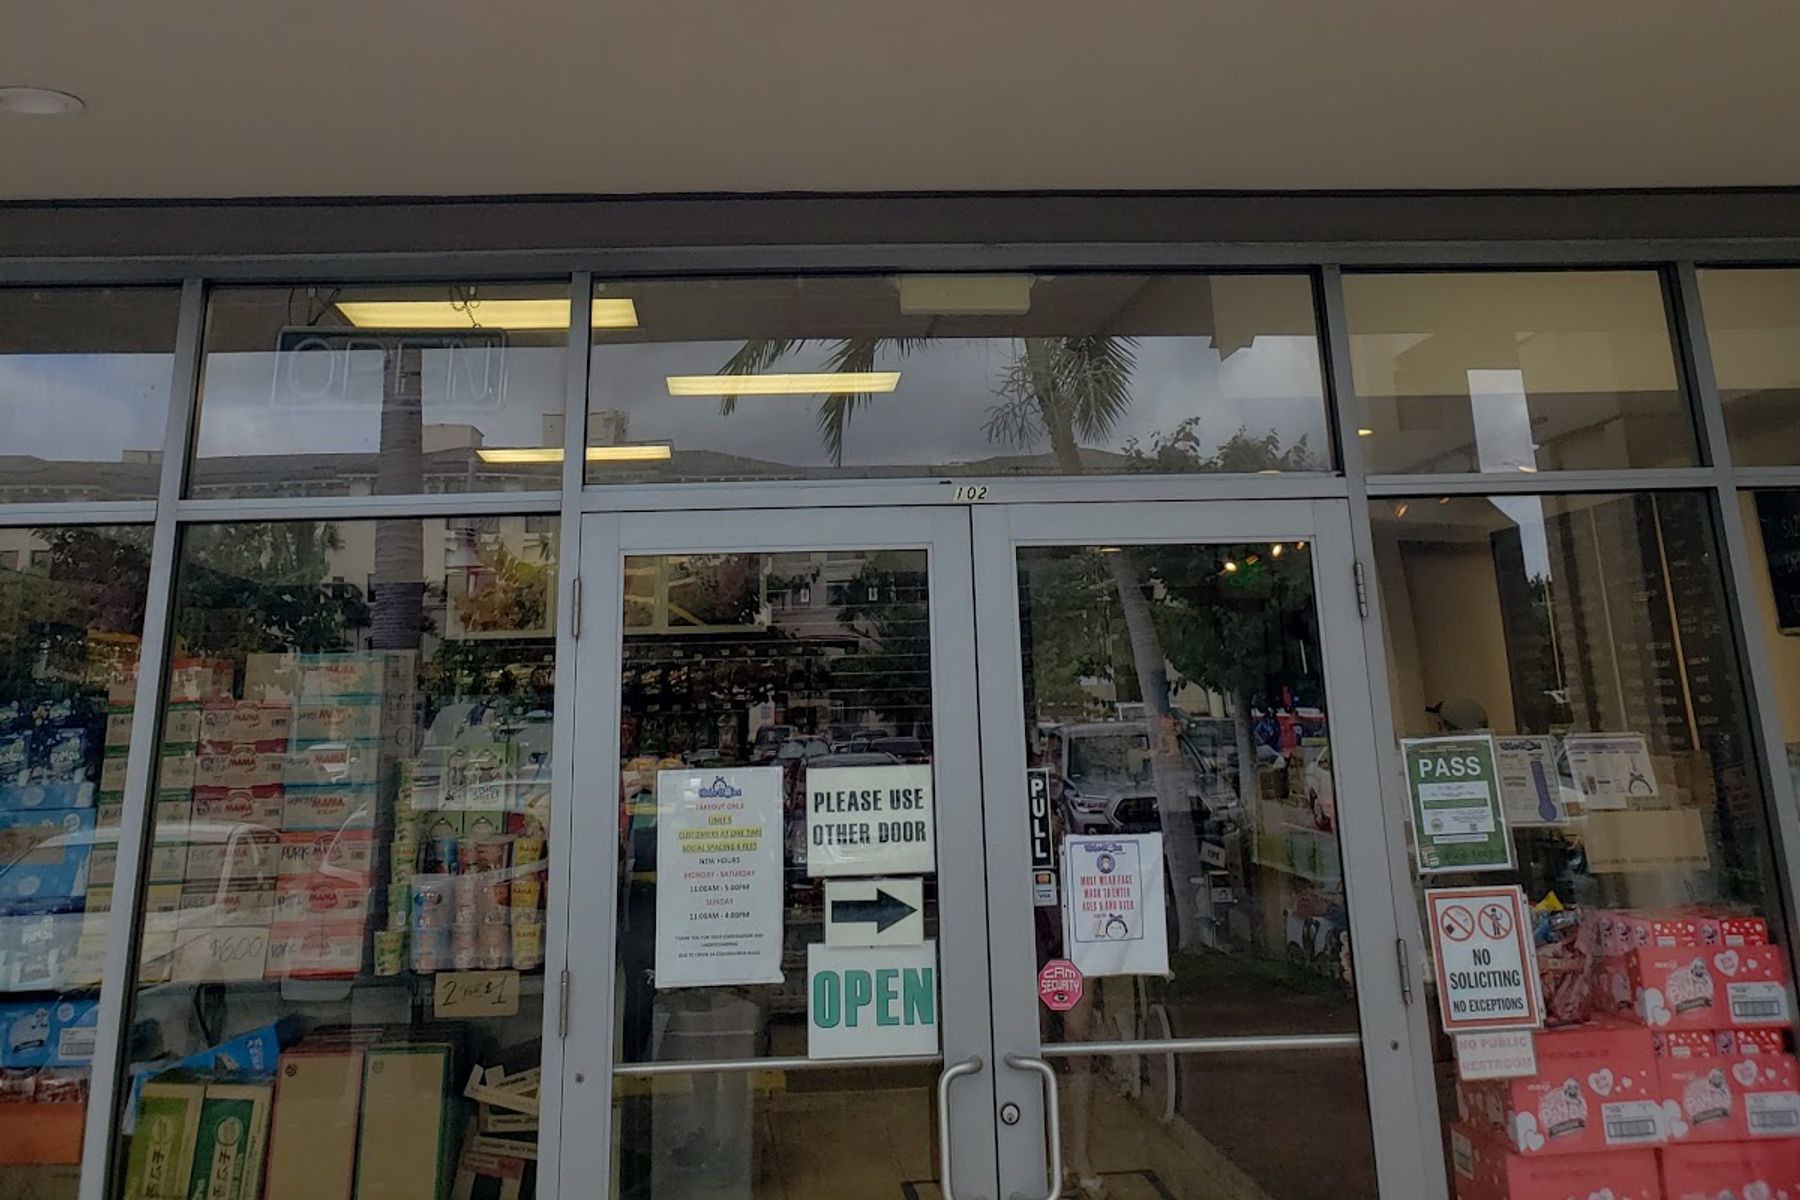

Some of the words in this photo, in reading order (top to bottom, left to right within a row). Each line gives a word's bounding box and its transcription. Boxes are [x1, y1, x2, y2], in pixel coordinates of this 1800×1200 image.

[288, 337, 491, 400] OPEN
[956, 486, 987, 500] 102
[228, 757, 257, 768] MAMA
[1418, 756, 1482, 778] PASS
[814, 790, 883, 813] PLEASE
[889, 788, 924, 810] USE
[1030, 779, 1047, 859] PULL
[813, 823, 871, 846] OTHER
[878, 821, 927, 843] DOOR
[720, 870, 756, 878] SATURDAY
[706, 898, 733, 906] SUNDAY
[1472, 948, 1491, 966] NO
[1041, 979, 1080, 993] SECURITY
[1450, 969, 1521, 990] SOLICITING
[442, 980, 458, 1007] 2
[813, 967, 934, 1028] OPEN
[1453, 1000, 1466, 1013] NO
[1470, 997, 1524, 1013] EXCEPTIONS
[1459, 1039, 1477, 1050] NO
[1481, 1036, 1528, 1049] PUBLIC
[1462, 1056, 1533, 1071] RESTROOM
